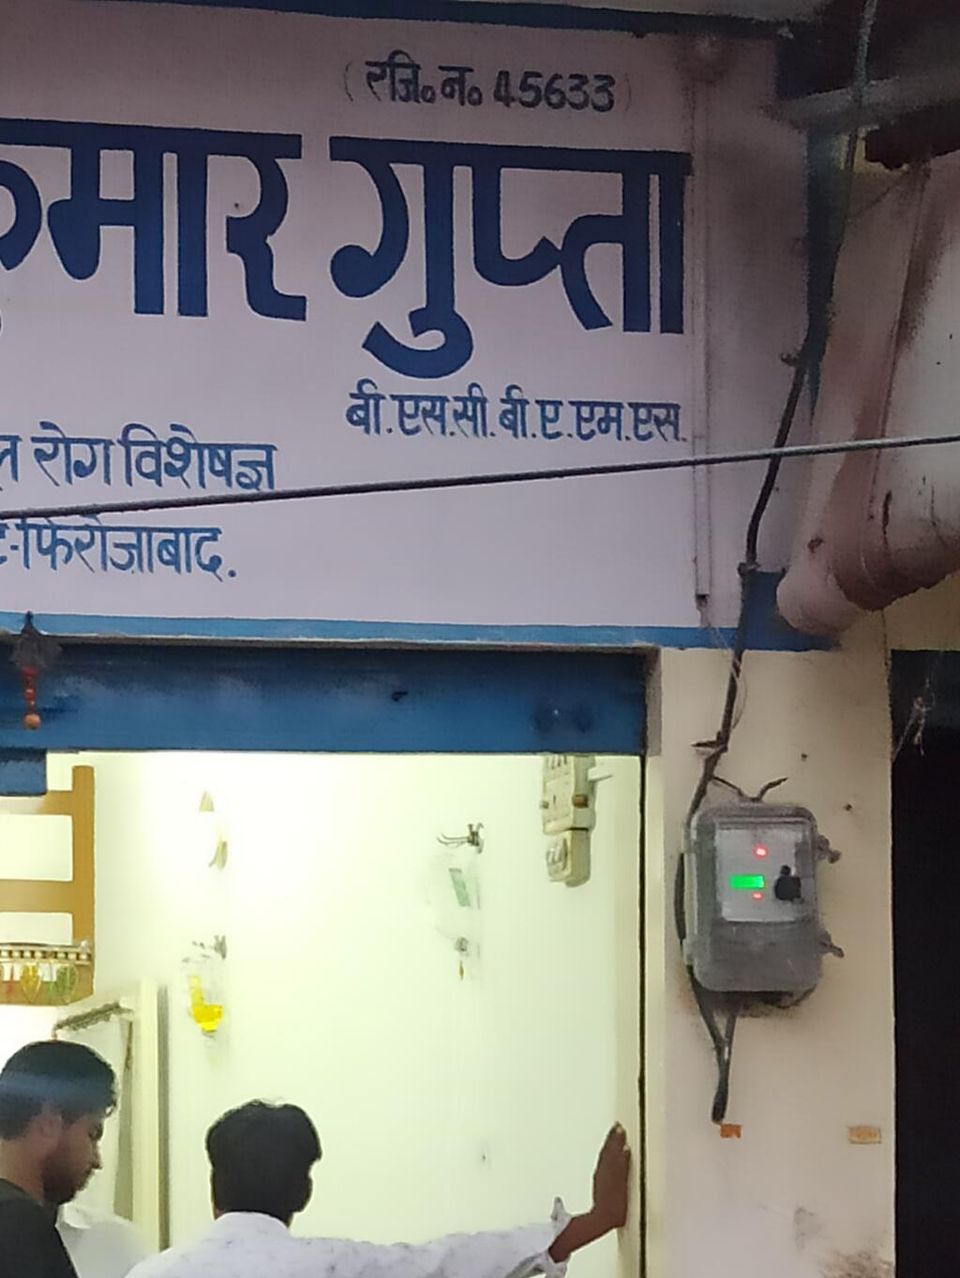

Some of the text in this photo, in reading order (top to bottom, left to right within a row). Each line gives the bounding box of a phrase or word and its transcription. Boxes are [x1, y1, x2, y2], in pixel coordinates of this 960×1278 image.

[328, 135, 692, 380] गुप्ता
[30, 421, 113, 487] रोग
[117, 422, 278, 490] विशेषज्ञ
